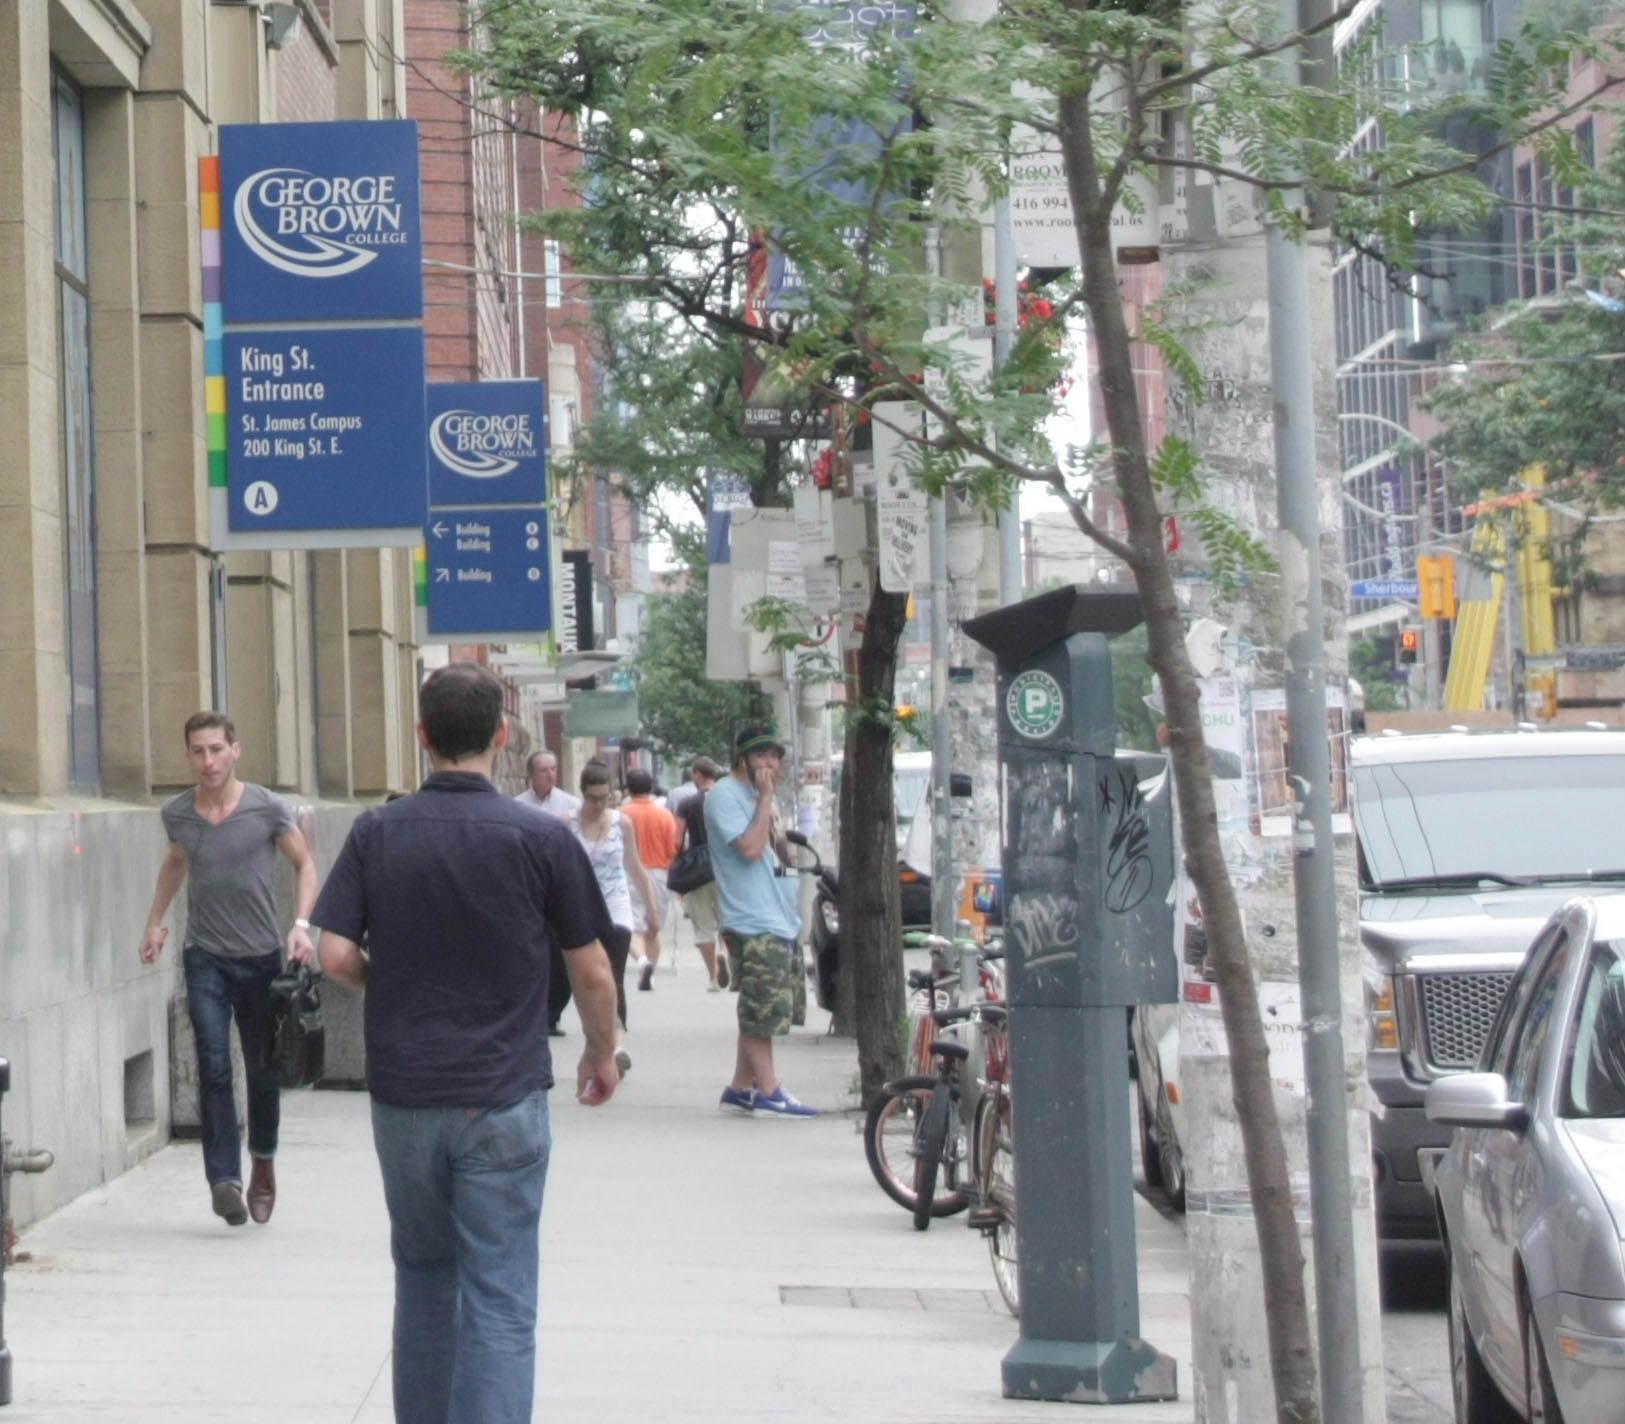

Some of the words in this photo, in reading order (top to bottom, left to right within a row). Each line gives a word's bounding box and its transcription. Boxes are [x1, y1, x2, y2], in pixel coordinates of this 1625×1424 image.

[259, 175, 396, 208] GEORGE
[1013, 197, 1038, 210] 416
[1043, 196, 1068, 209] 994
[277, 203, 402, 234] BROWN
[345, 231, 408, 245] COLLEGE
[240, 346, 284, 377] King
[290, 346, 316, 371] St.
[241, 376, 325, 402] Entrance
[242, 414, 261, 433] St.
[264, 414, 307, 432] James
[310, 412, 363, 433] Campus
[444, 413, 530, 435] GEORGE
[243, 438, 271, 457] 200
[274, 438, 305, 459] King
[308, 437, 327, 456] St.
[331, 437, 344, 454] E.
[456, 430, 535, 451] BROWN
[455, 522, 491, 537] Building
[456, 538, 491, 552] Building
[457, 567, 492, 583] Building
[1364, 580, 1418, 595] Sherbour
[561, 562, 578, 653] MONTAUK
[1025, 688, 1048, 714] P
